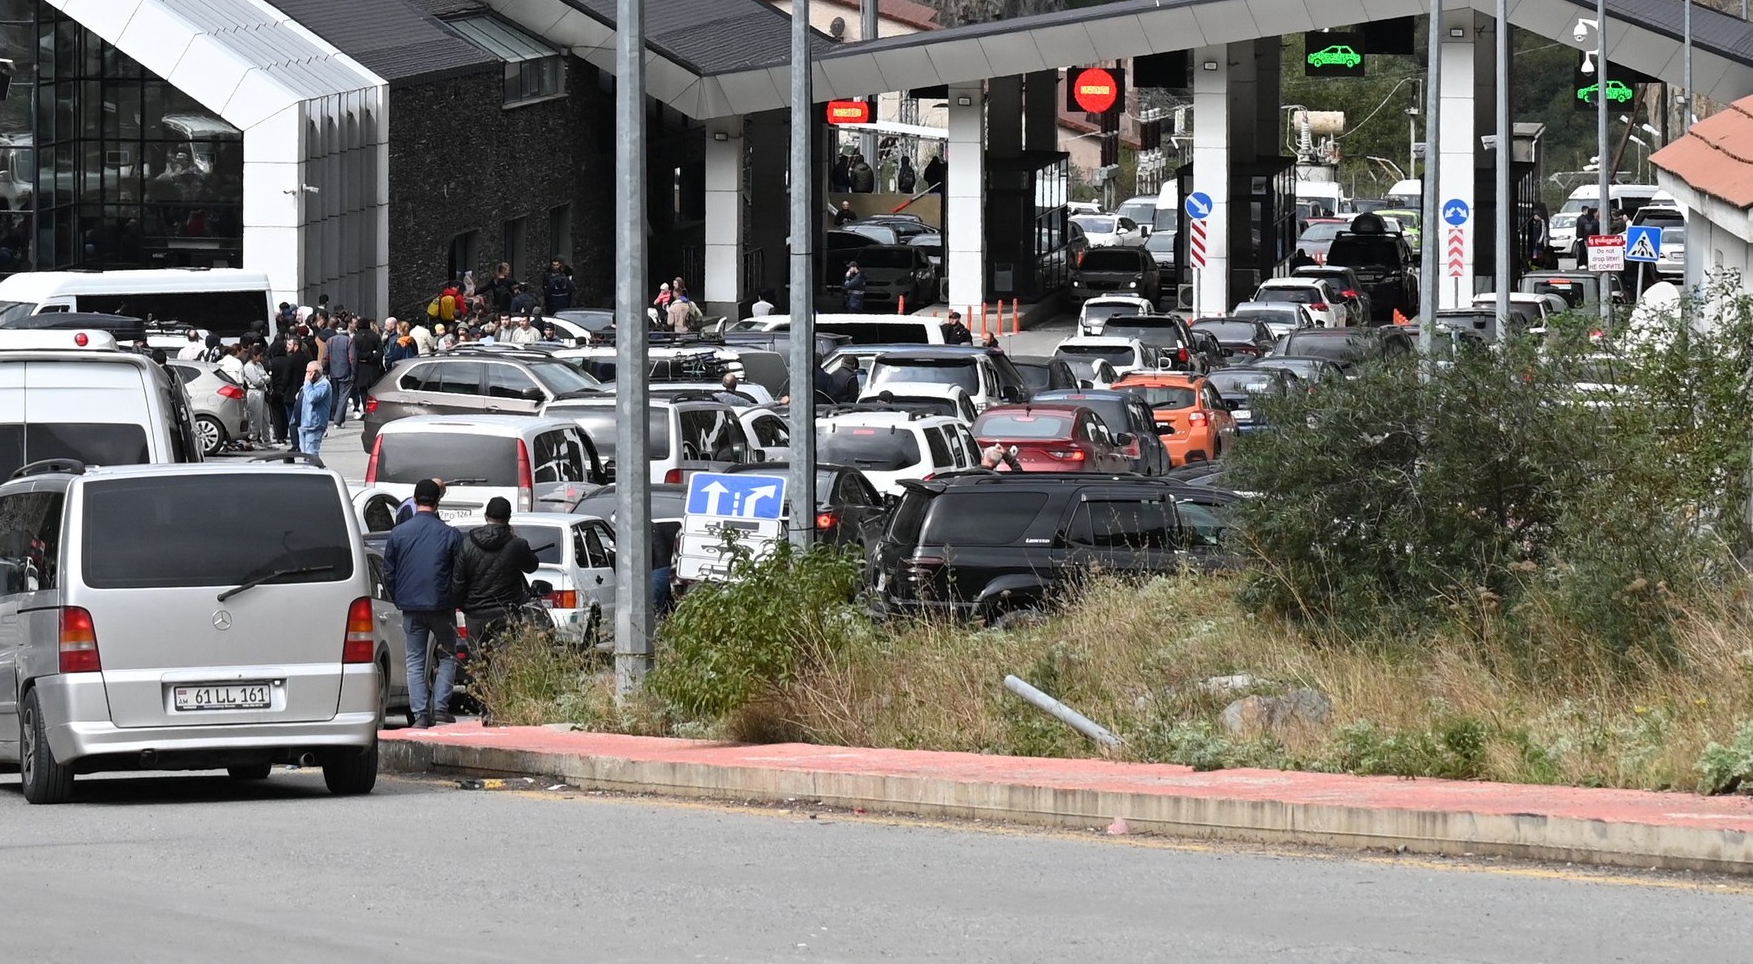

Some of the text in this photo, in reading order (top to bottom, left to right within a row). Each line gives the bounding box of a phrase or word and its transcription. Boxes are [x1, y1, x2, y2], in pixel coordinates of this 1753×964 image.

[195, 689, 212, 705] 61
[215, 688, 236, 704] LL
[240, 687, 266, 703] 161
